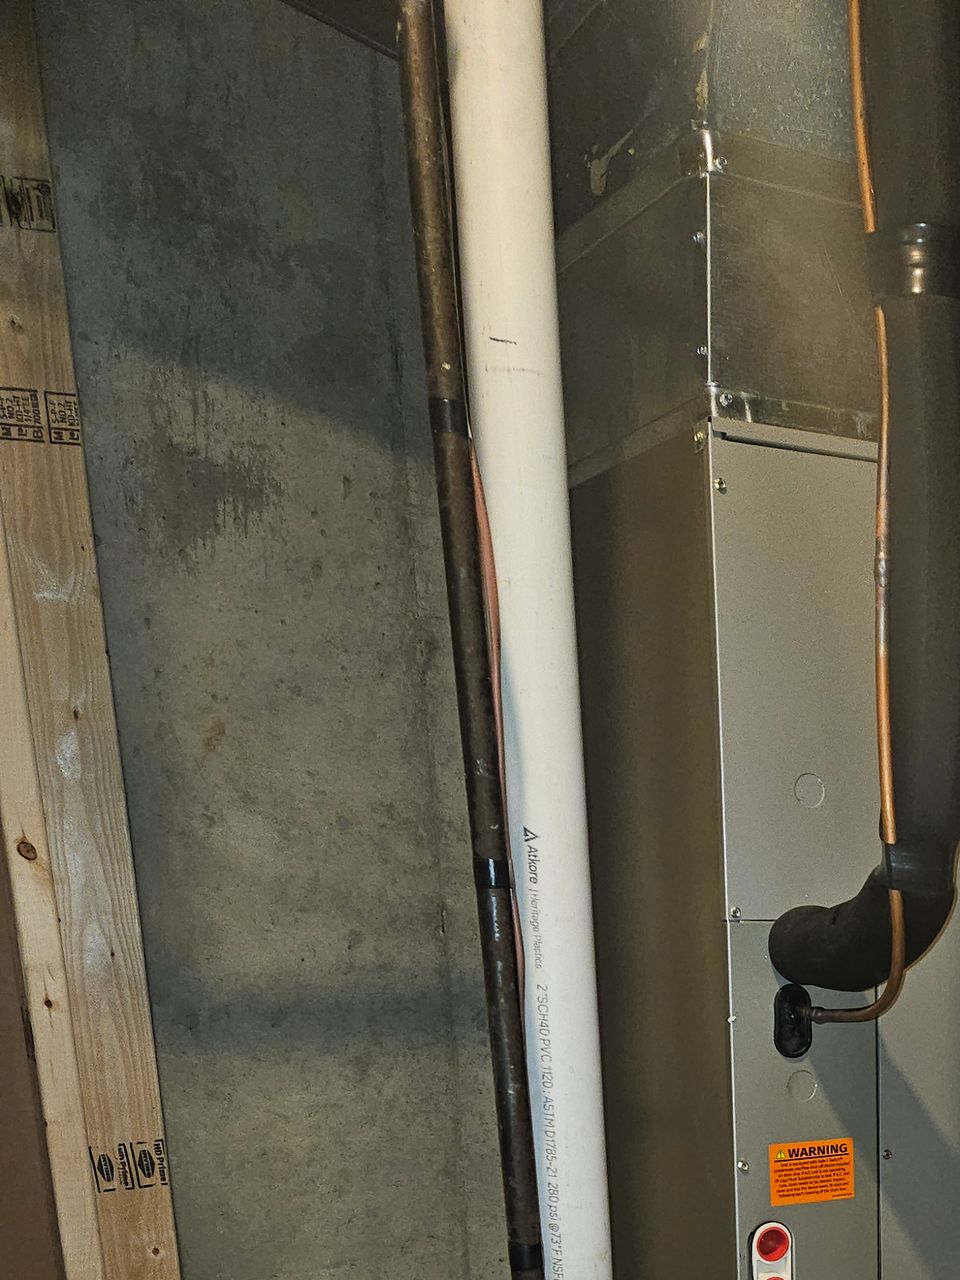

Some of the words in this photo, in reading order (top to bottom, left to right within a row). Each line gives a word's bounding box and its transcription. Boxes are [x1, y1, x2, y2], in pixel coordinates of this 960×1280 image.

[527, 844, 540, 885] Atkore
[540, 1038, 553, 1063] PVC
[543, 1095, 556, 1128] ASTM
[788, 1143, 848, 1158] WARNING
[547, 1182, 560, 1203] 280
[547, 1203, 560, 1221] psi
